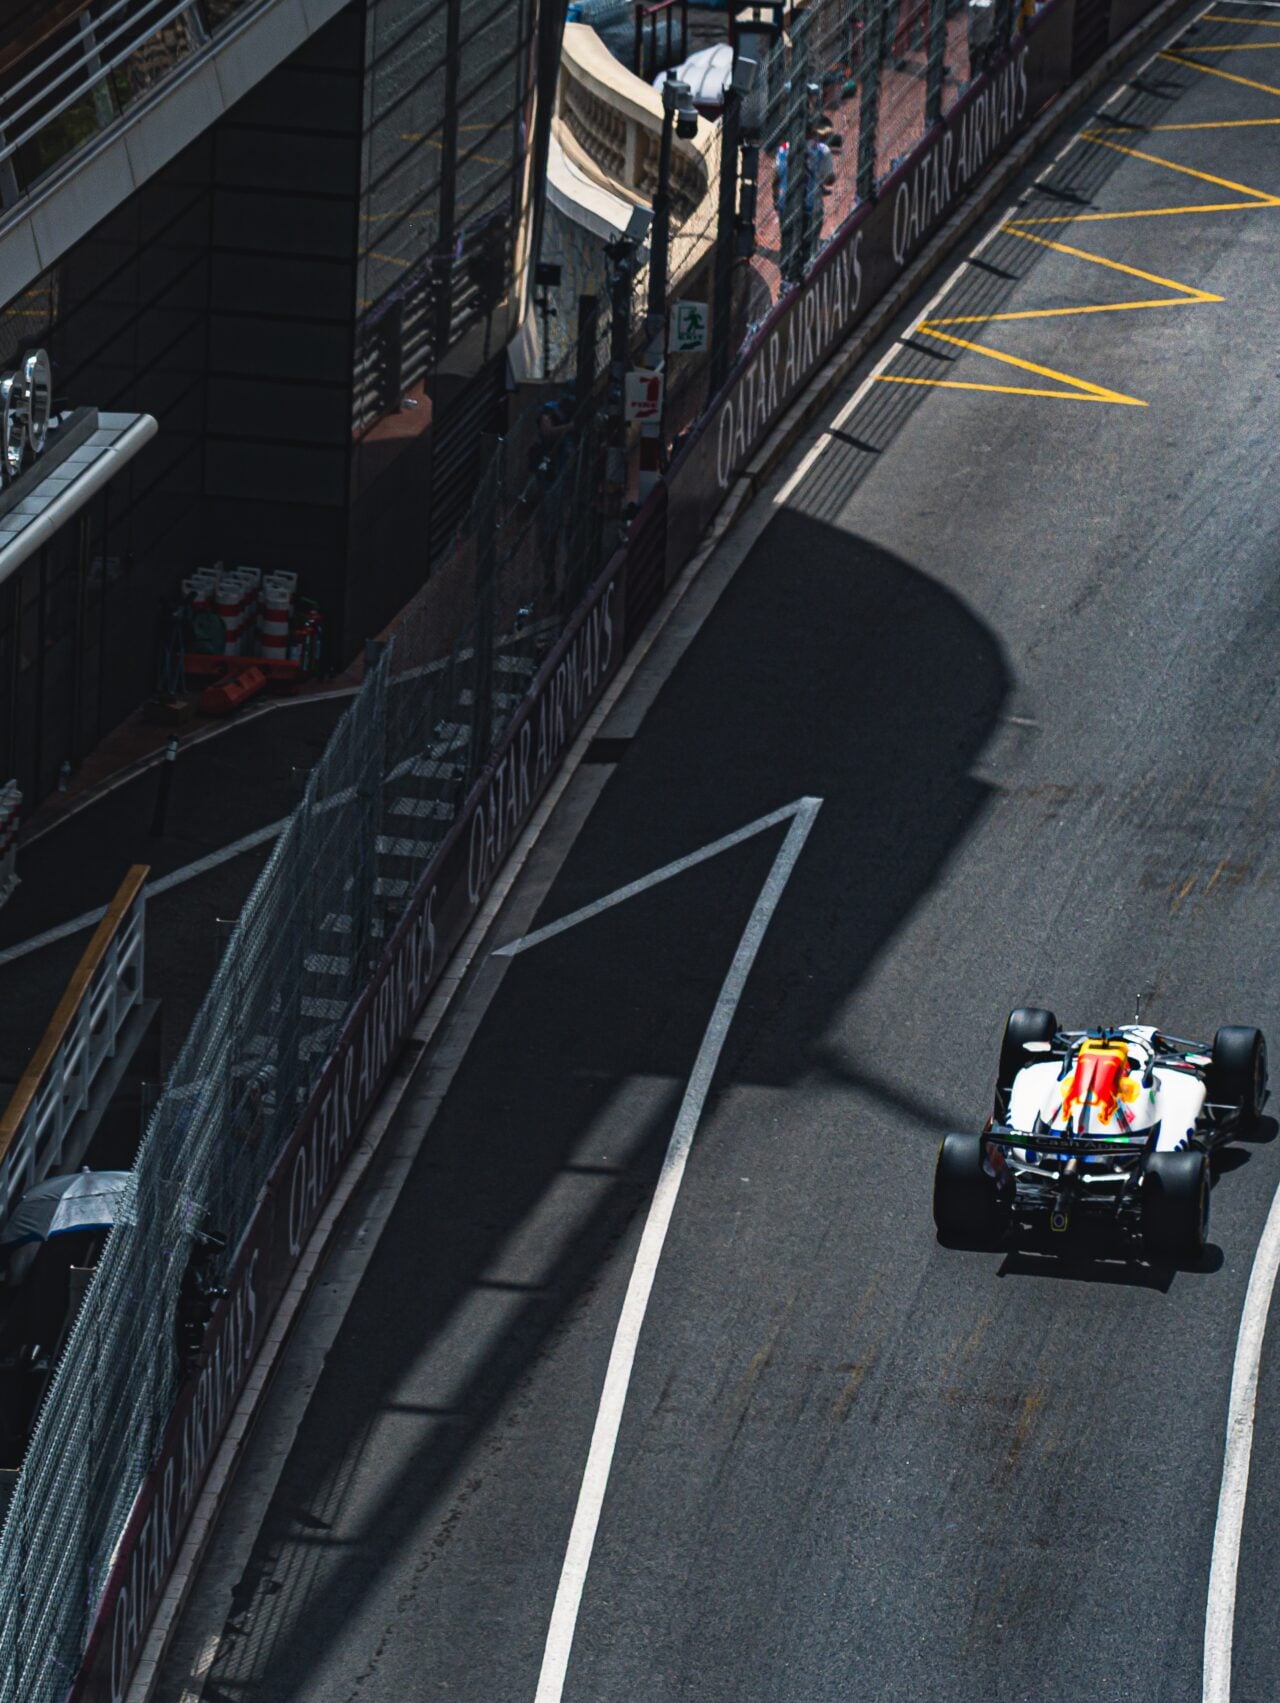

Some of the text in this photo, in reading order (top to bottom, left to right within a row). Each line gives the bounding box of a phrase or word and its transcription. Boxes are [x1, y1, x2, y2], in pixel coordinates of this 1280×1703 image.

[893, 45, 1029, 265] QATAR AIRWAYS
[717, 230, 863, 489] QATAR AIRWAYS
[468, 580, 615, 905] QATAR AIRWAYS
[289, 884, 438, 1257] QATAR AIRWAYS
[111, 1248, 258, 1703] QATAR AIRWAYS
